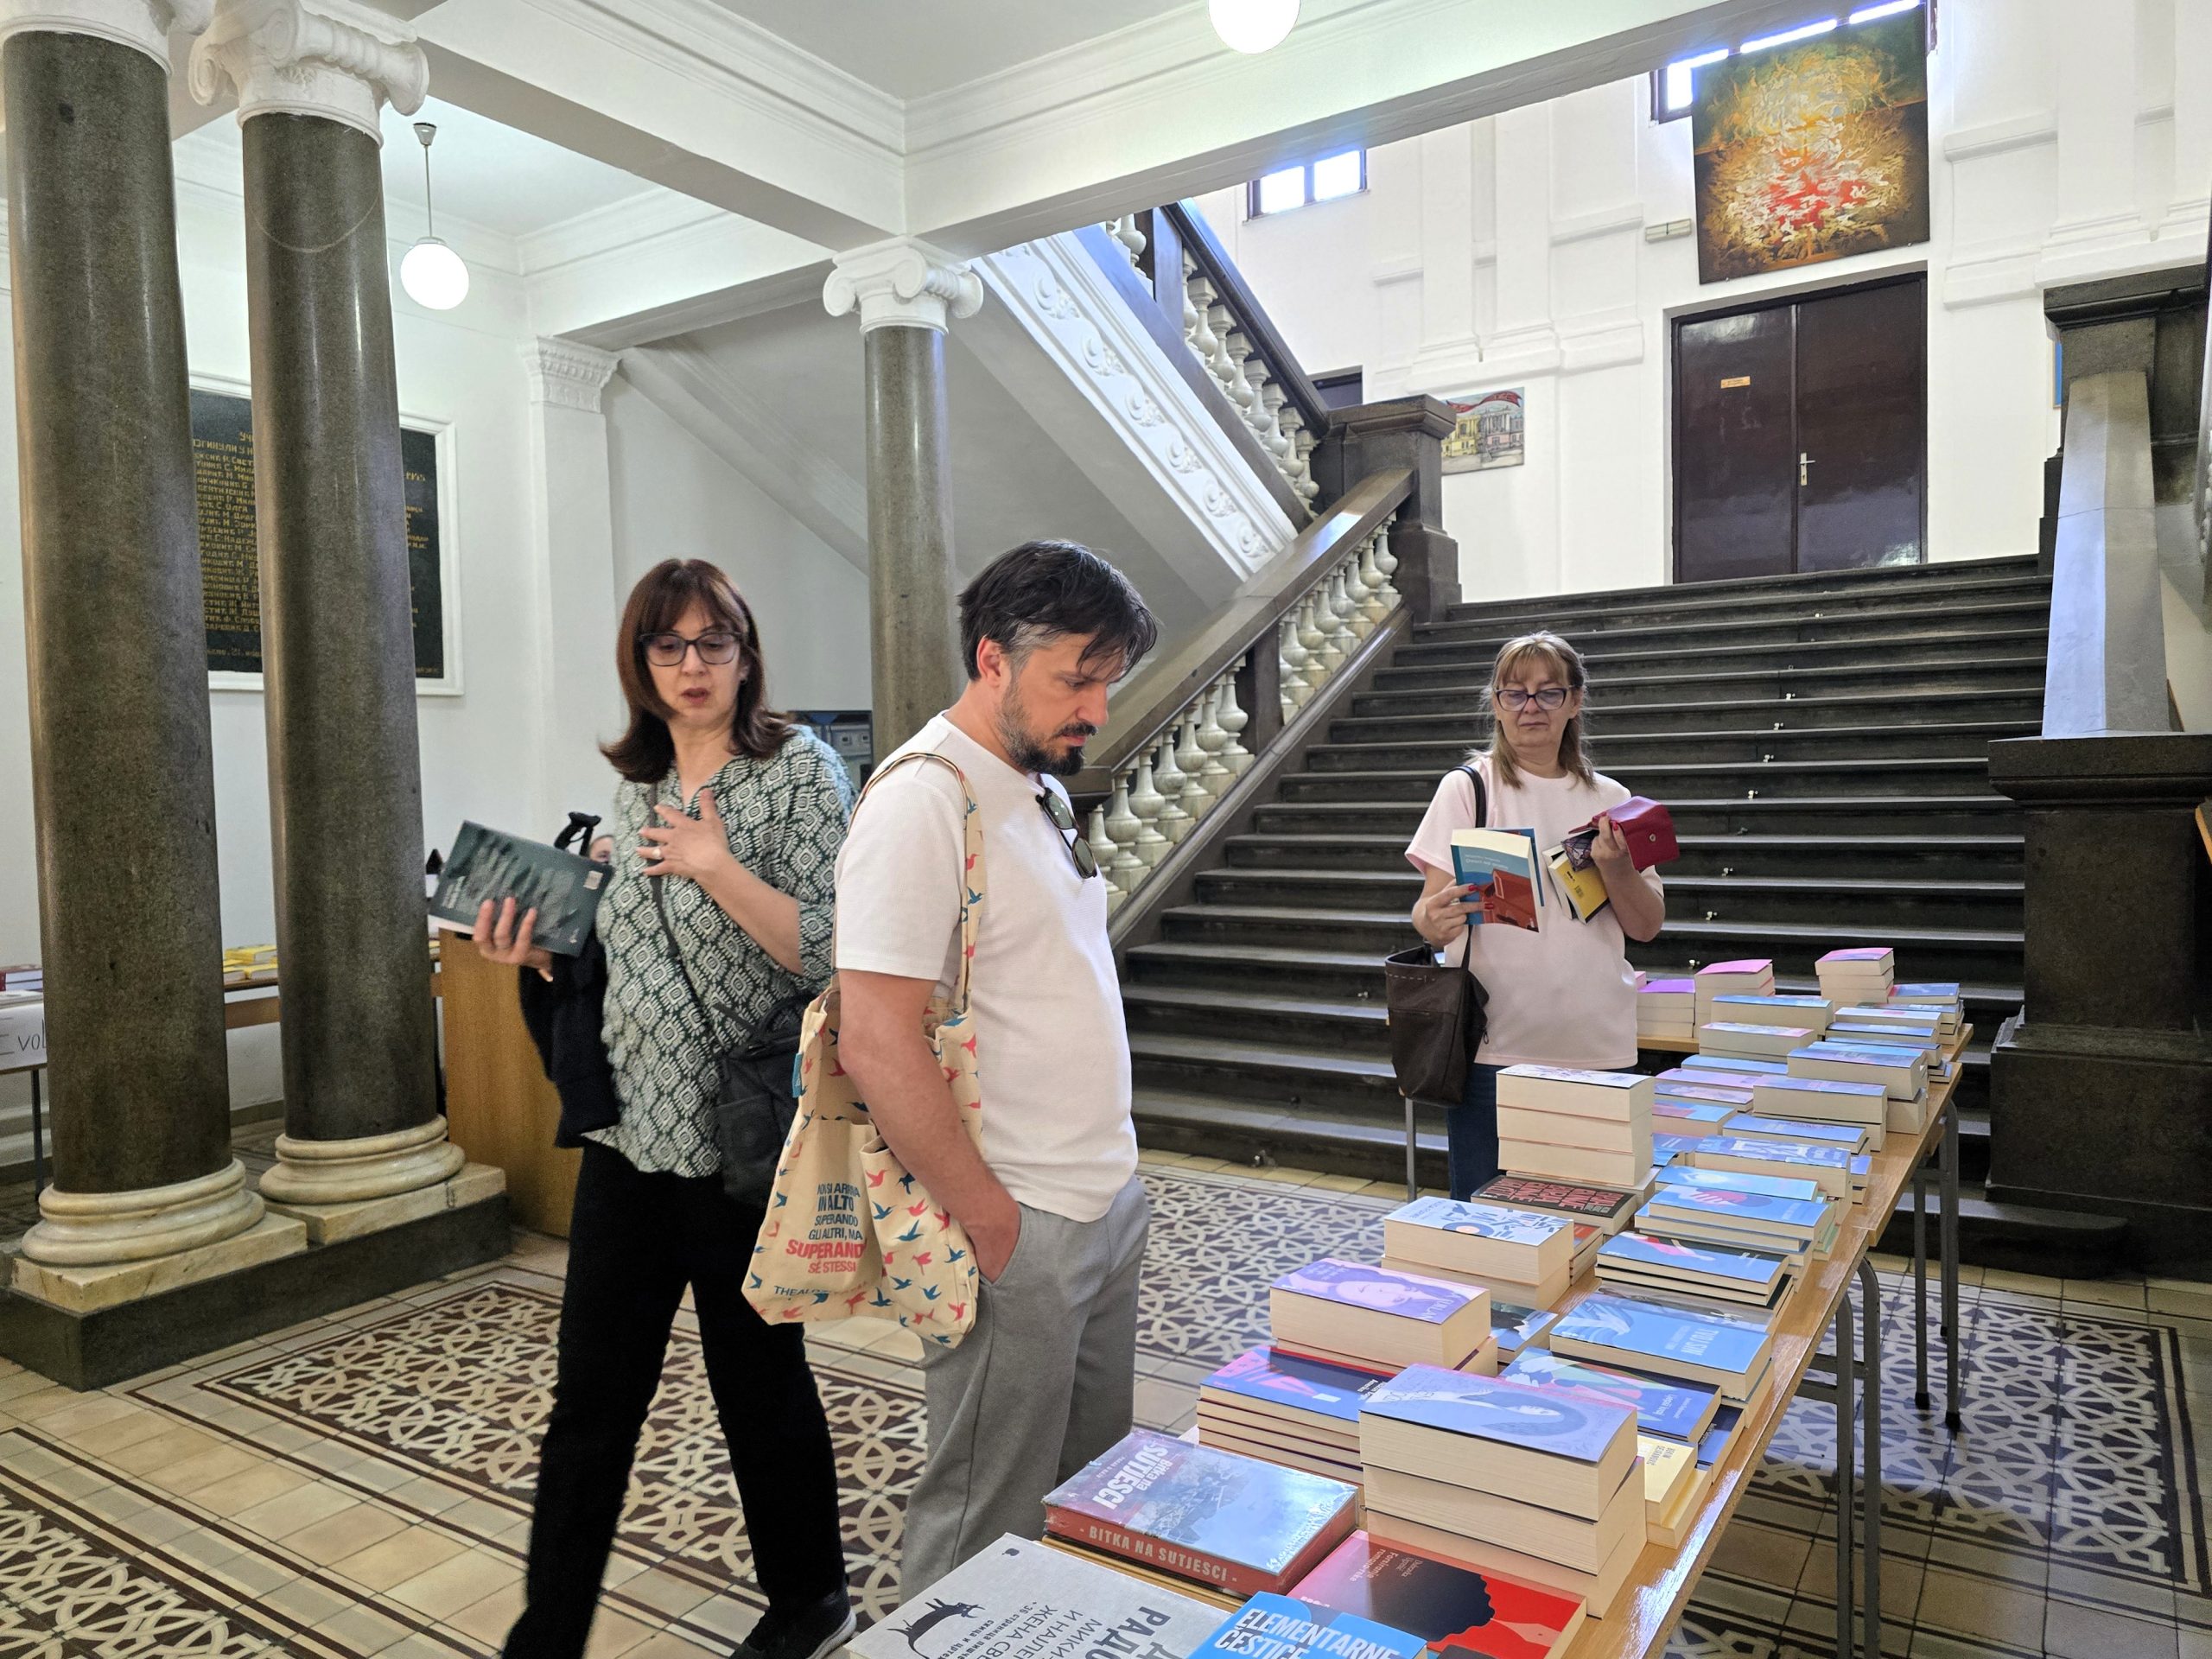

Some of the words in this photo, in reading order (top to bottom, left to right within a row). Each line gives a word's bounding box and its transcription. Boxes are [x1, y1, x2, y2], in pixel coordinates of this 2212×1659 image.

[828, 1195, 854, 1211] ALTO
[815, 1214, 858, 1227] SUPERANDO
[849, 1230, 863, 1240] MA
[823, 1261, 856, 1273] STESSI
[1091, 1442, 1170, 1510] SUTJESCI
[1147, 1459, 1173, 1483] Bitka
[1139, 1478, 1151, 1492] na
[1089, 1525, 1130, 1550] BITKA
[1135, 1540, 1154, 1558] NA
[1158, 1547, 1227, 1581] SUTJESCI
[1366, 1552, 1400, 1580] Forsiranje
[1006, 1605, 1058, 1640] ЖЕНА
[1064, 1610, 1084, 1621] И
[969, 1619, 995, 1637] скица
[983, 1613, 1020, 1641] страница
[1235, 1607, 1401, 1659] ELEMENTARNE
